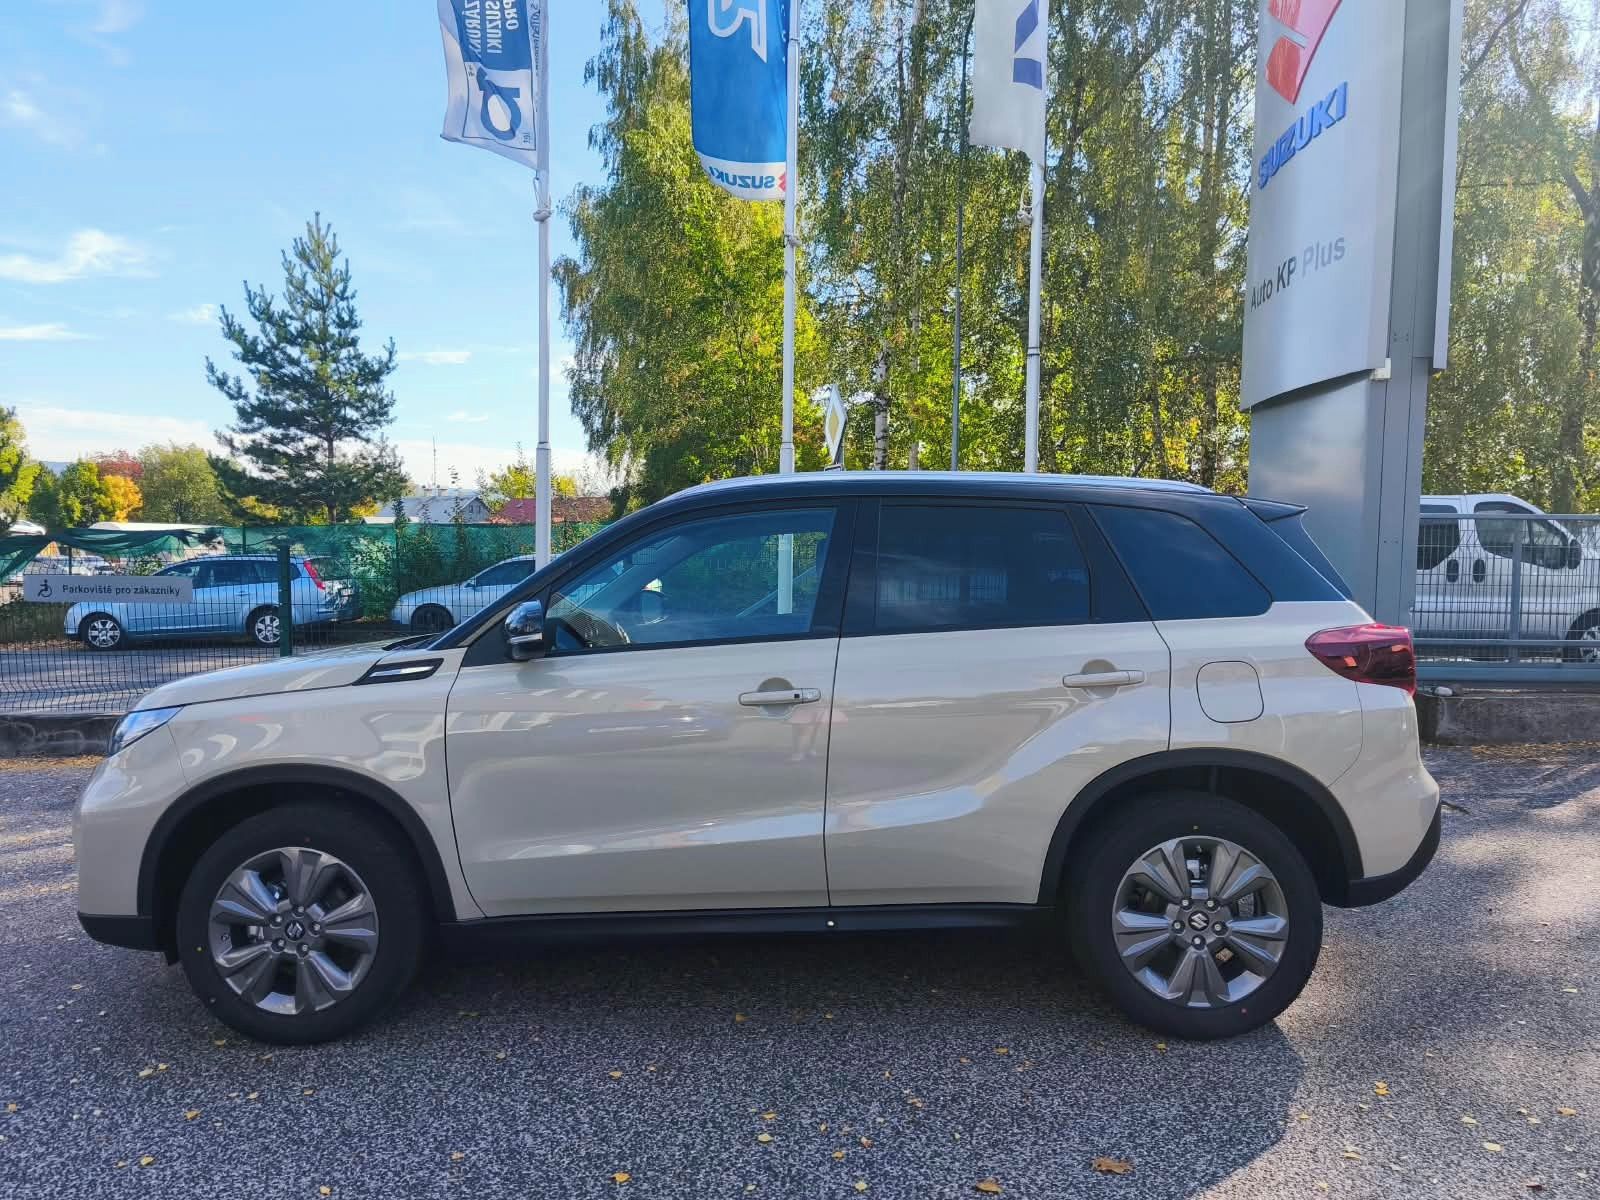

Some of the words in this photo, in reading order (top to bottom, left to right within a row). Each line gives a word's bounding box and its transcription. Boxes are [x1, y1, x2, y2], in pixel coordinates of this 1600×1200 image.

[1258, 81, 1347, 190] SUZUKI
[1250, 279, 1273, 313] Auto
[1276, 255, 1297, 293] KP
[1302, 236, 1346, 278] Plus
[62, 583, 112, 594] Parkoviště
[115, 585, 131, 596] pro
[133, 584, 180, 597] zákazníky
